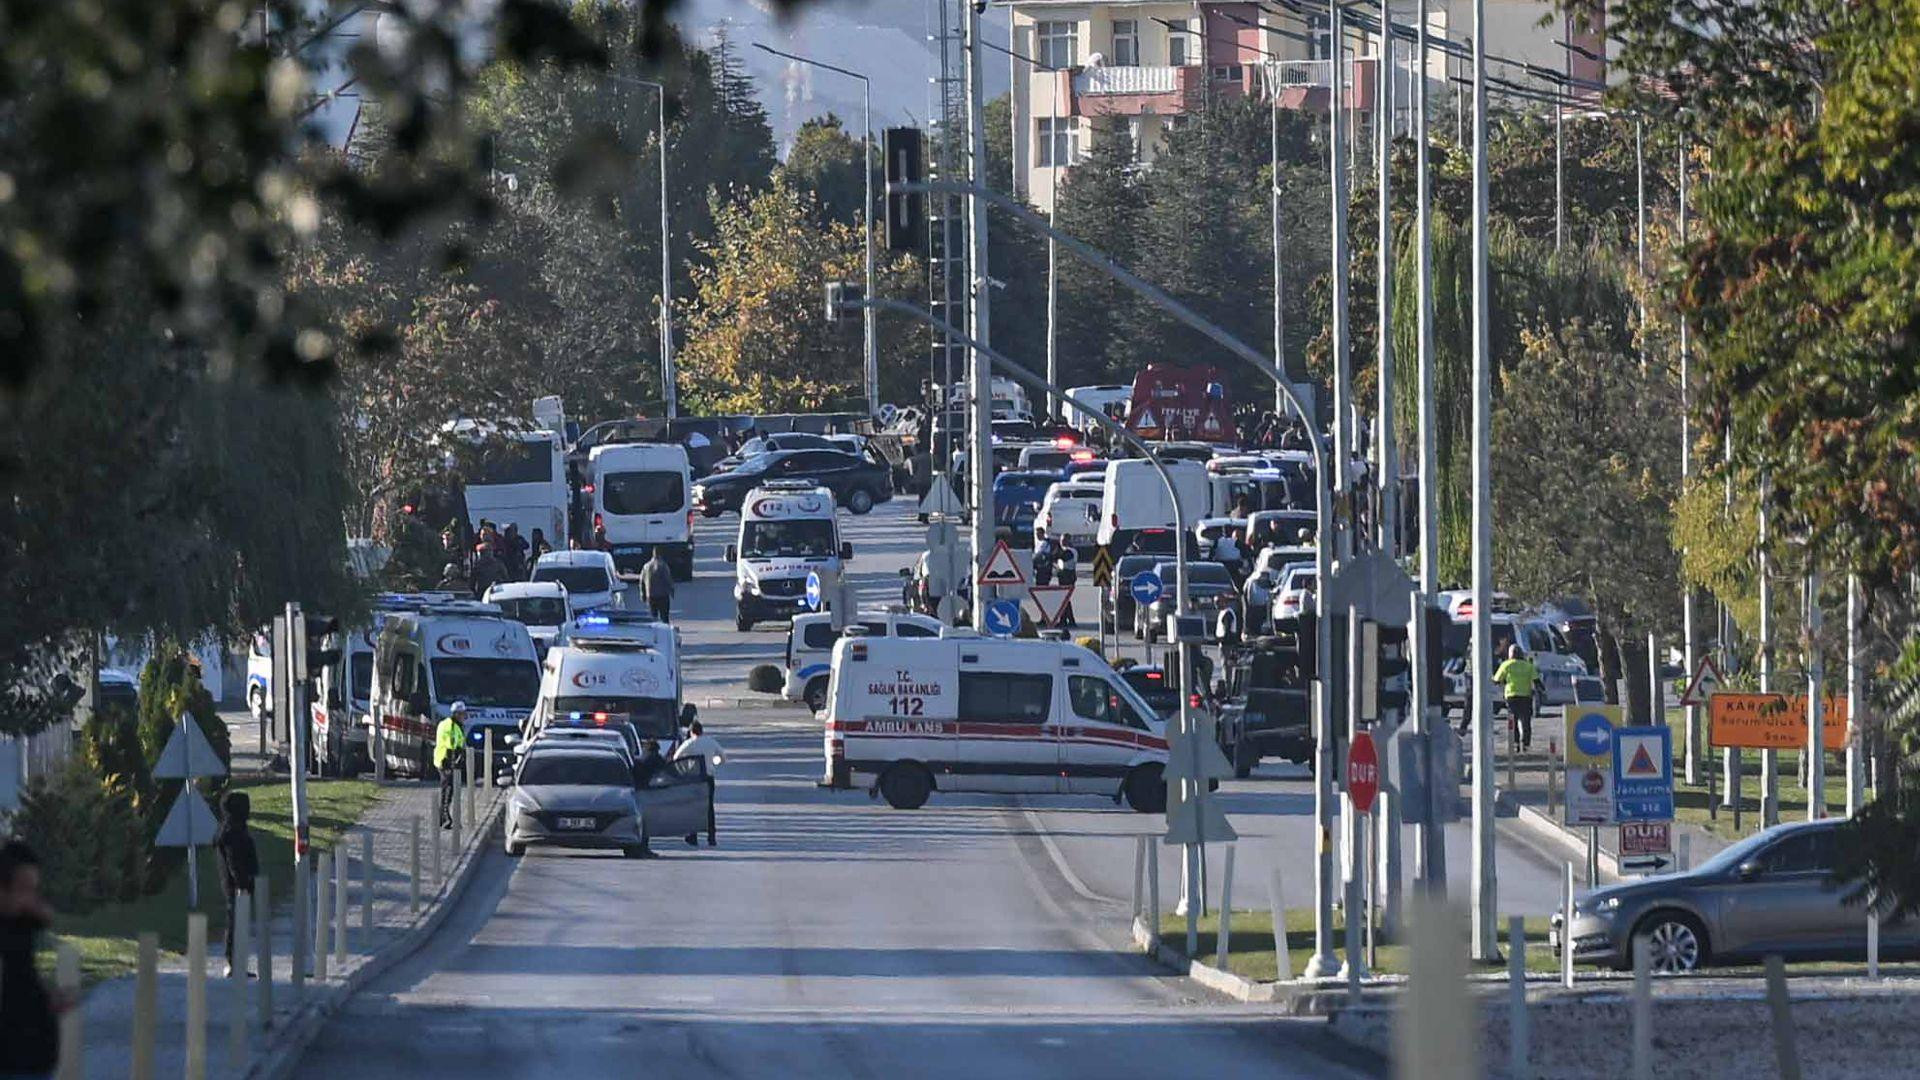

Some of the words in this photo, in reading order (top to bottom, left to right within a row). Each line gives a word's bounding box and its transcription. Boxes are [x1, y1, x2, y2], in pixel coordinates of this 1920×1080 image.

[889, 697, 924, 715] 112
[865, 719, 944, 733] AMBULANS
[1351, 762, 1375, 782] DUR
[1617, 784, 1671, 795] Jandarma
[1642, 803, 1660, 812] 112
[1626, 825, 1665, 837] DUR
